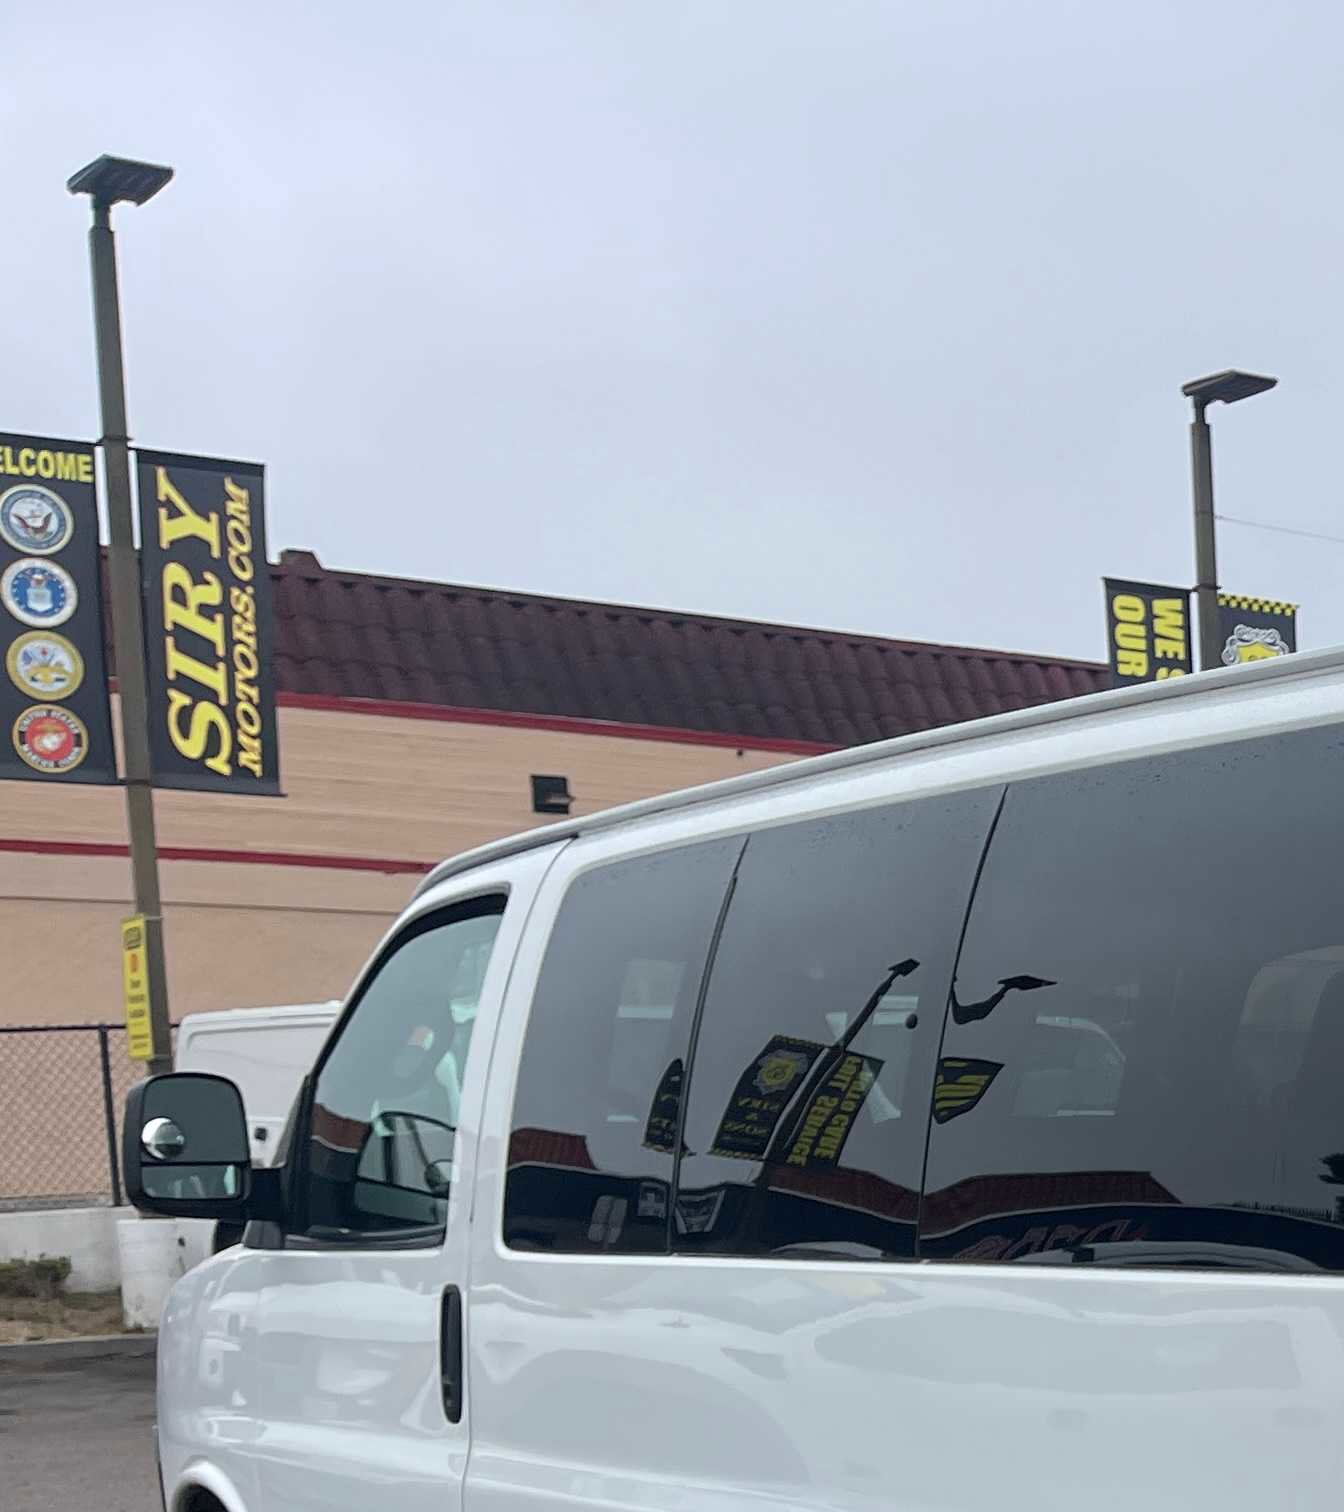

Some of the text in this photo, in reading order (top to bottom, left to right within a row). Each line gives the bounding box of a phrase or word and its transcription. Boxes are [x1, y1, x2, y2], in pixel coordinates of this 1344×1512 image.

[0, 446, 94, 483] LCOME
[155, 465, 232, 776] SIRY
[224, 476, 264, 778] MOTORS.COM
[1112, 594, 1148, 677] OUR
[1152, 598, 1186, 661] WE
